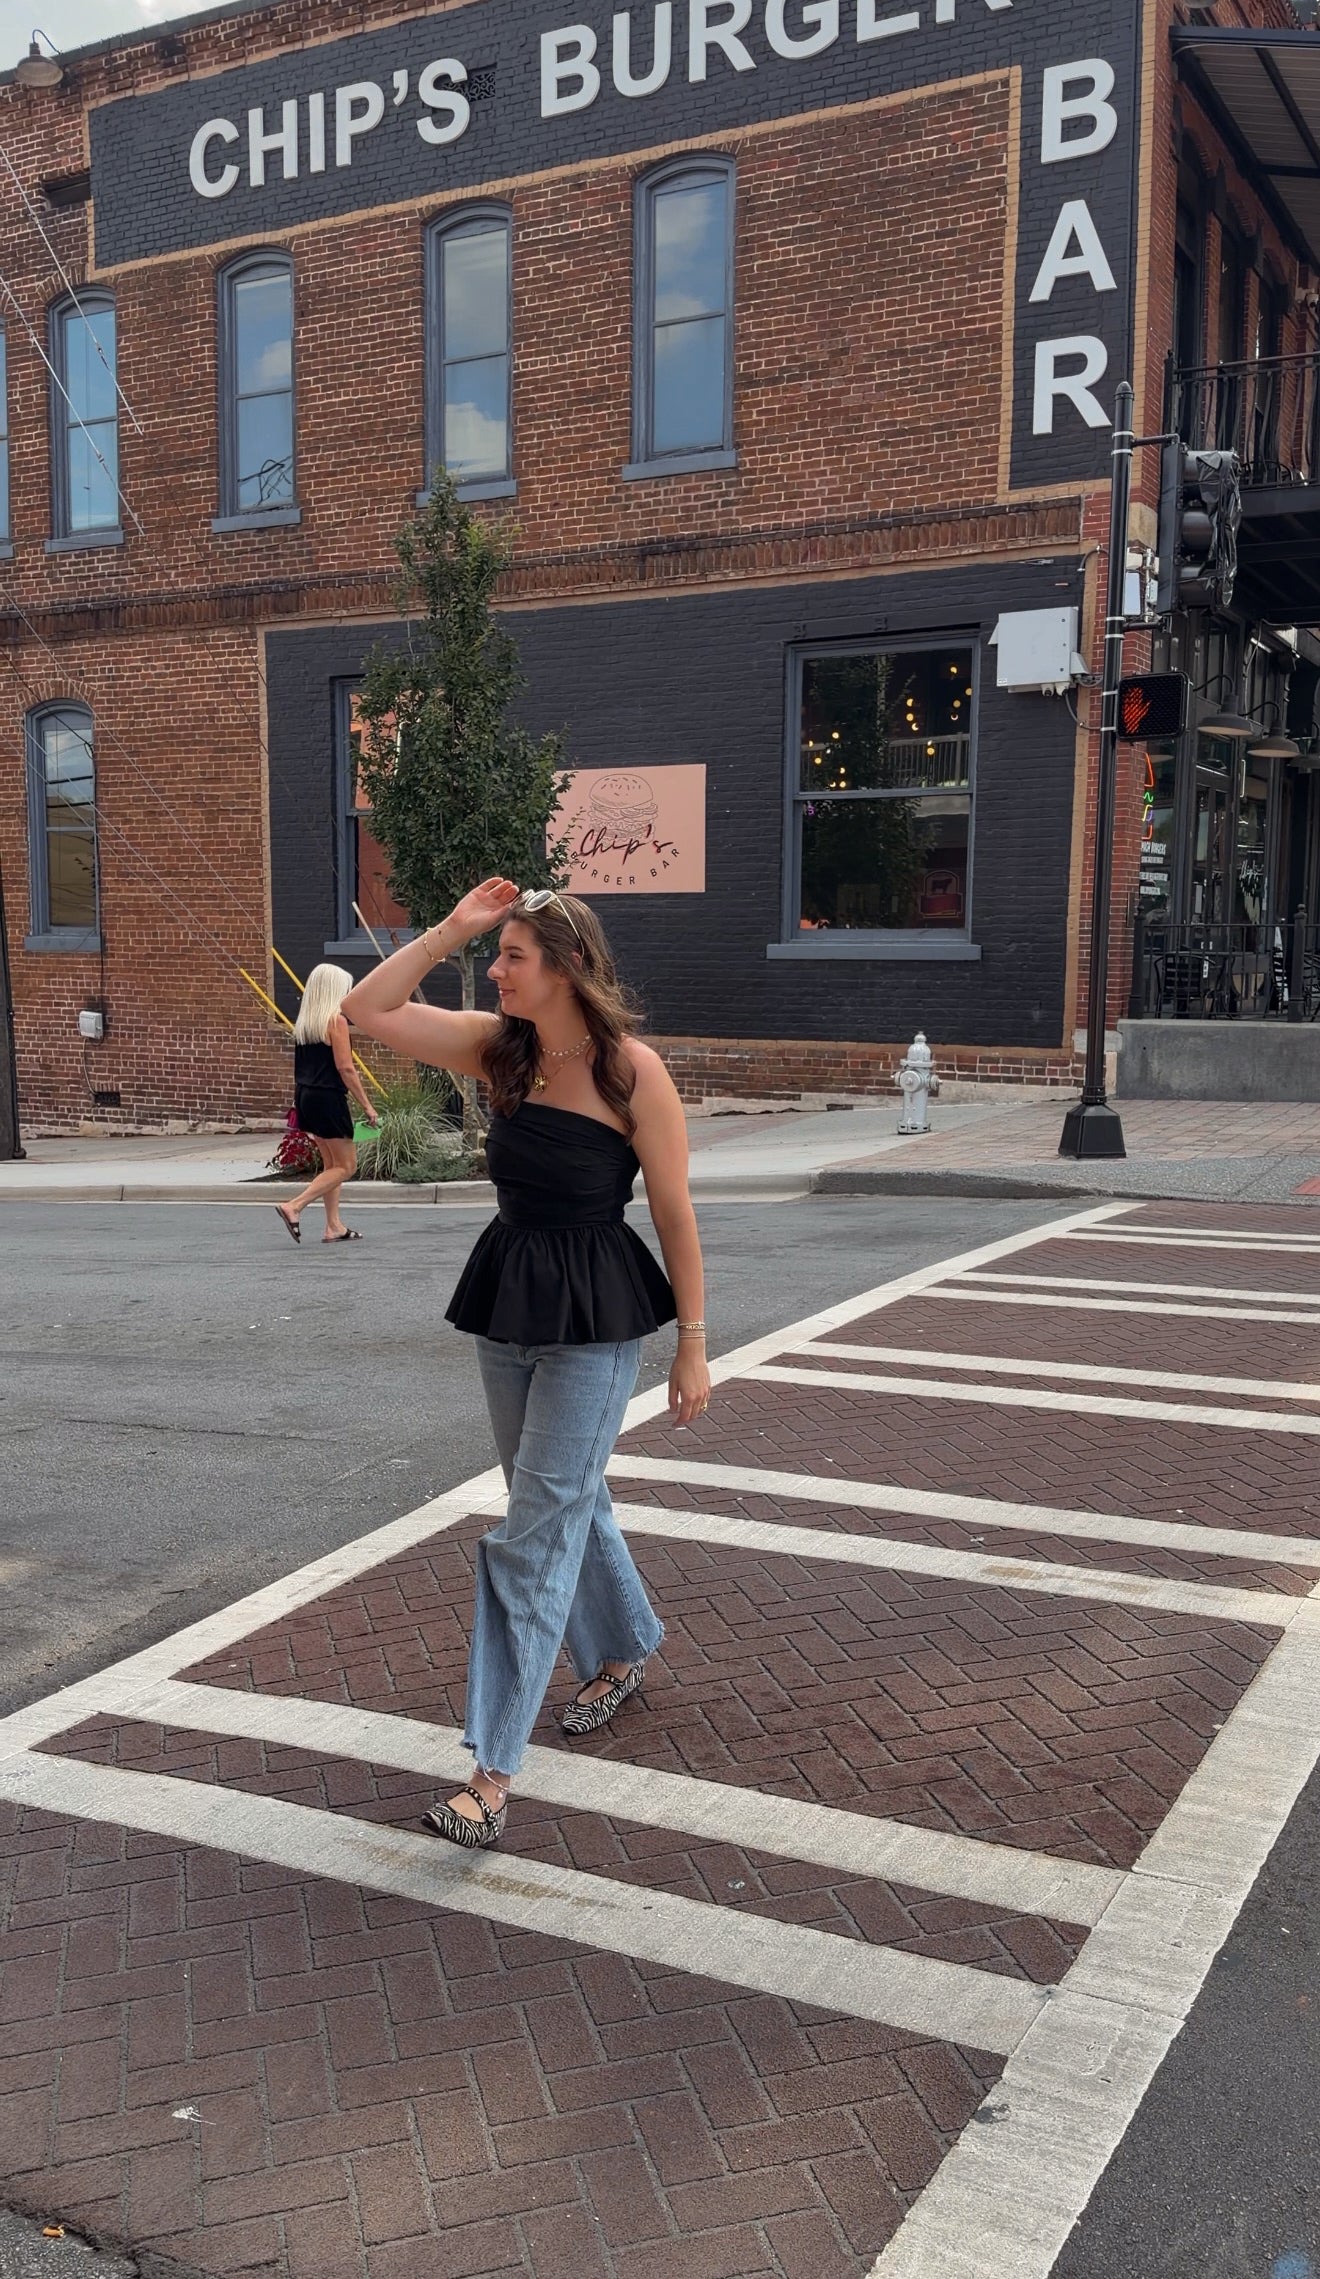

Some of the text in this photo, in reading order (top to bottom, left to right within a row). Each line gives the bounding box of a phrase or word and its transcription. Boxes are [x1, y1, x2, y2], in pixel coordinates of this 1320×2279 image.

[189, 0, 1014, 199] CHIP'S BURG
[1028, 57, 1119, 436] BAR
[570, 848, 680, 886] BURGER BAR
[577, 823, 674, 866] Chip's
